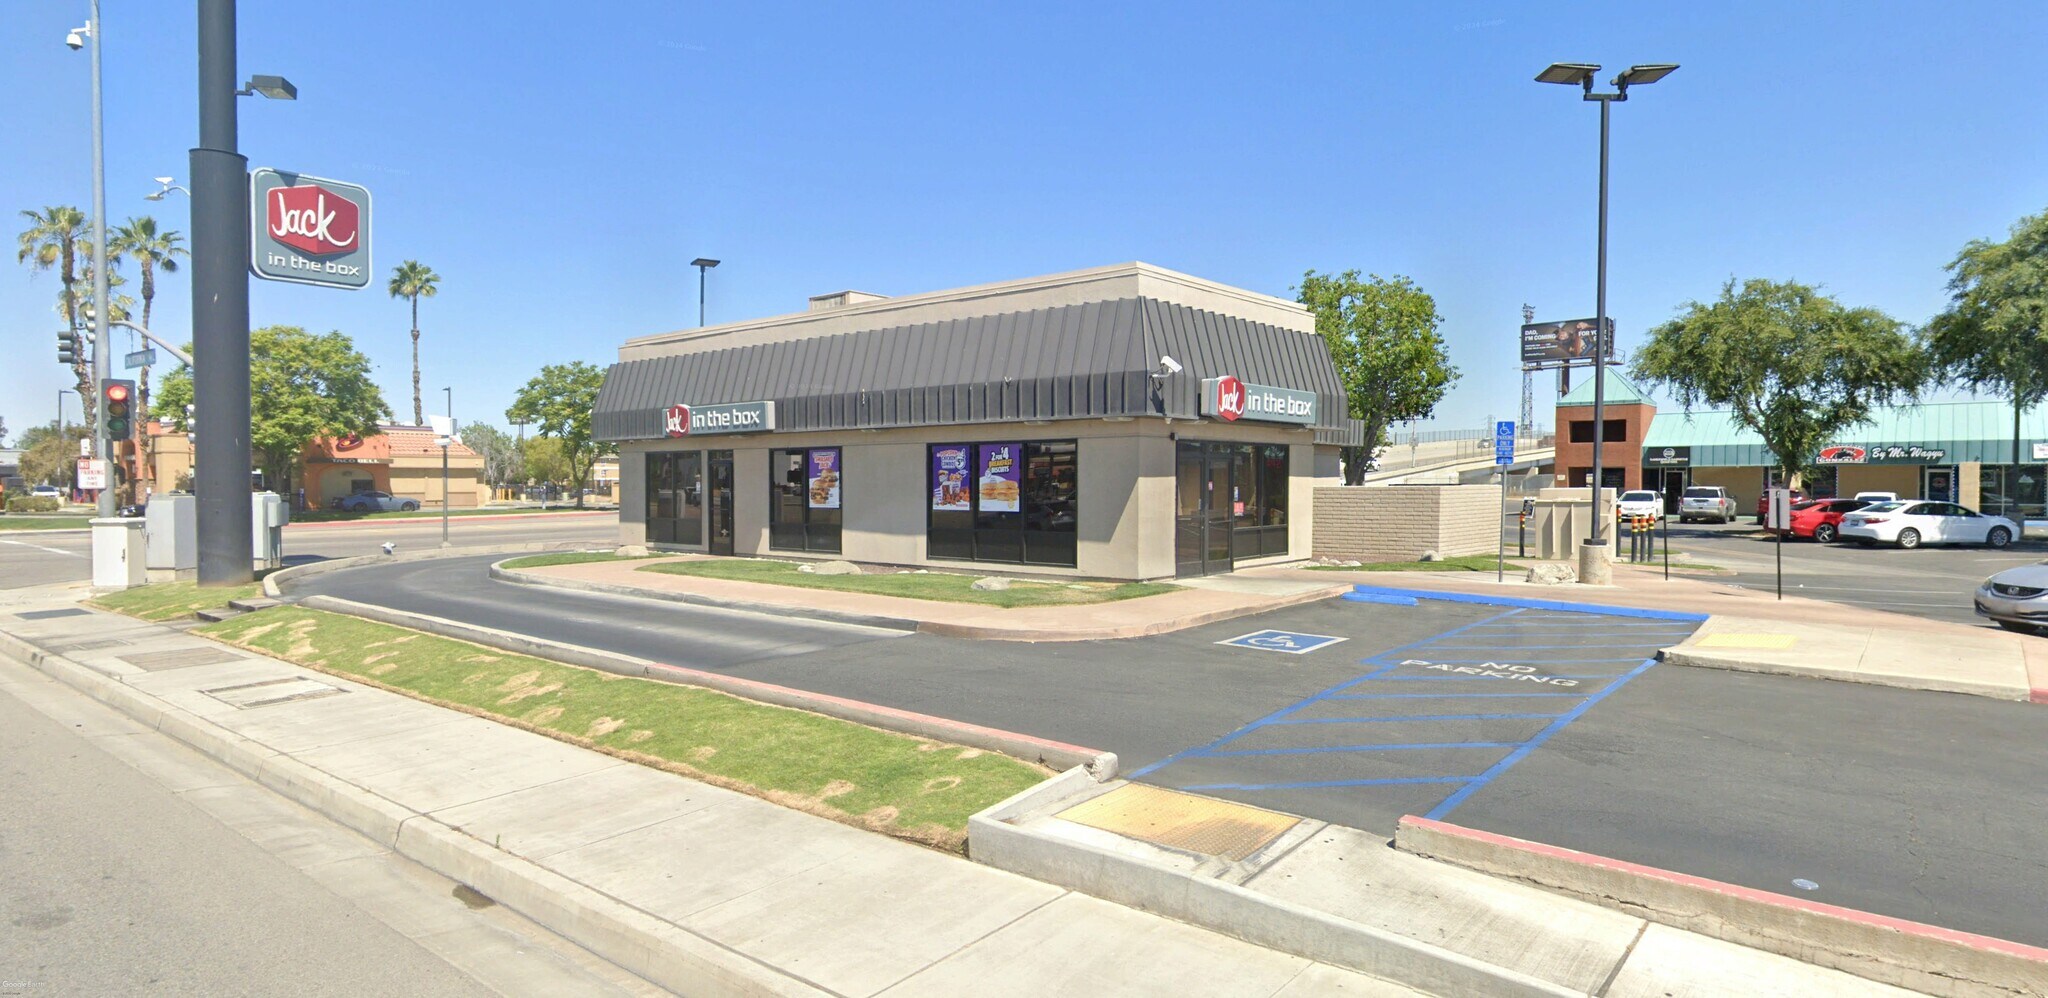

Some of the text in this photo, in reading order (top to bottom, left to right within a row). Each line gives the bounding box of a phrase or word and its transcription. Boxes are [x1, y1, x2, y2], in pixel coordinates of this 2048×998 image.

[272, 192, 355, 246] Jack
[268, 252, 360, 276] in the box
[1219, 382, 1312, 416] Jack in the box
[666, 408, 760, 433] Jack in the box
[1871, 447, 1886, 460] By
[1888, 447, 1908, 458] Mr.
[1910, 446, 1944, 461] Wagyu
[1400, 660, 1580, 686] PARKING
[1480, 662, 1537, 673] NO
